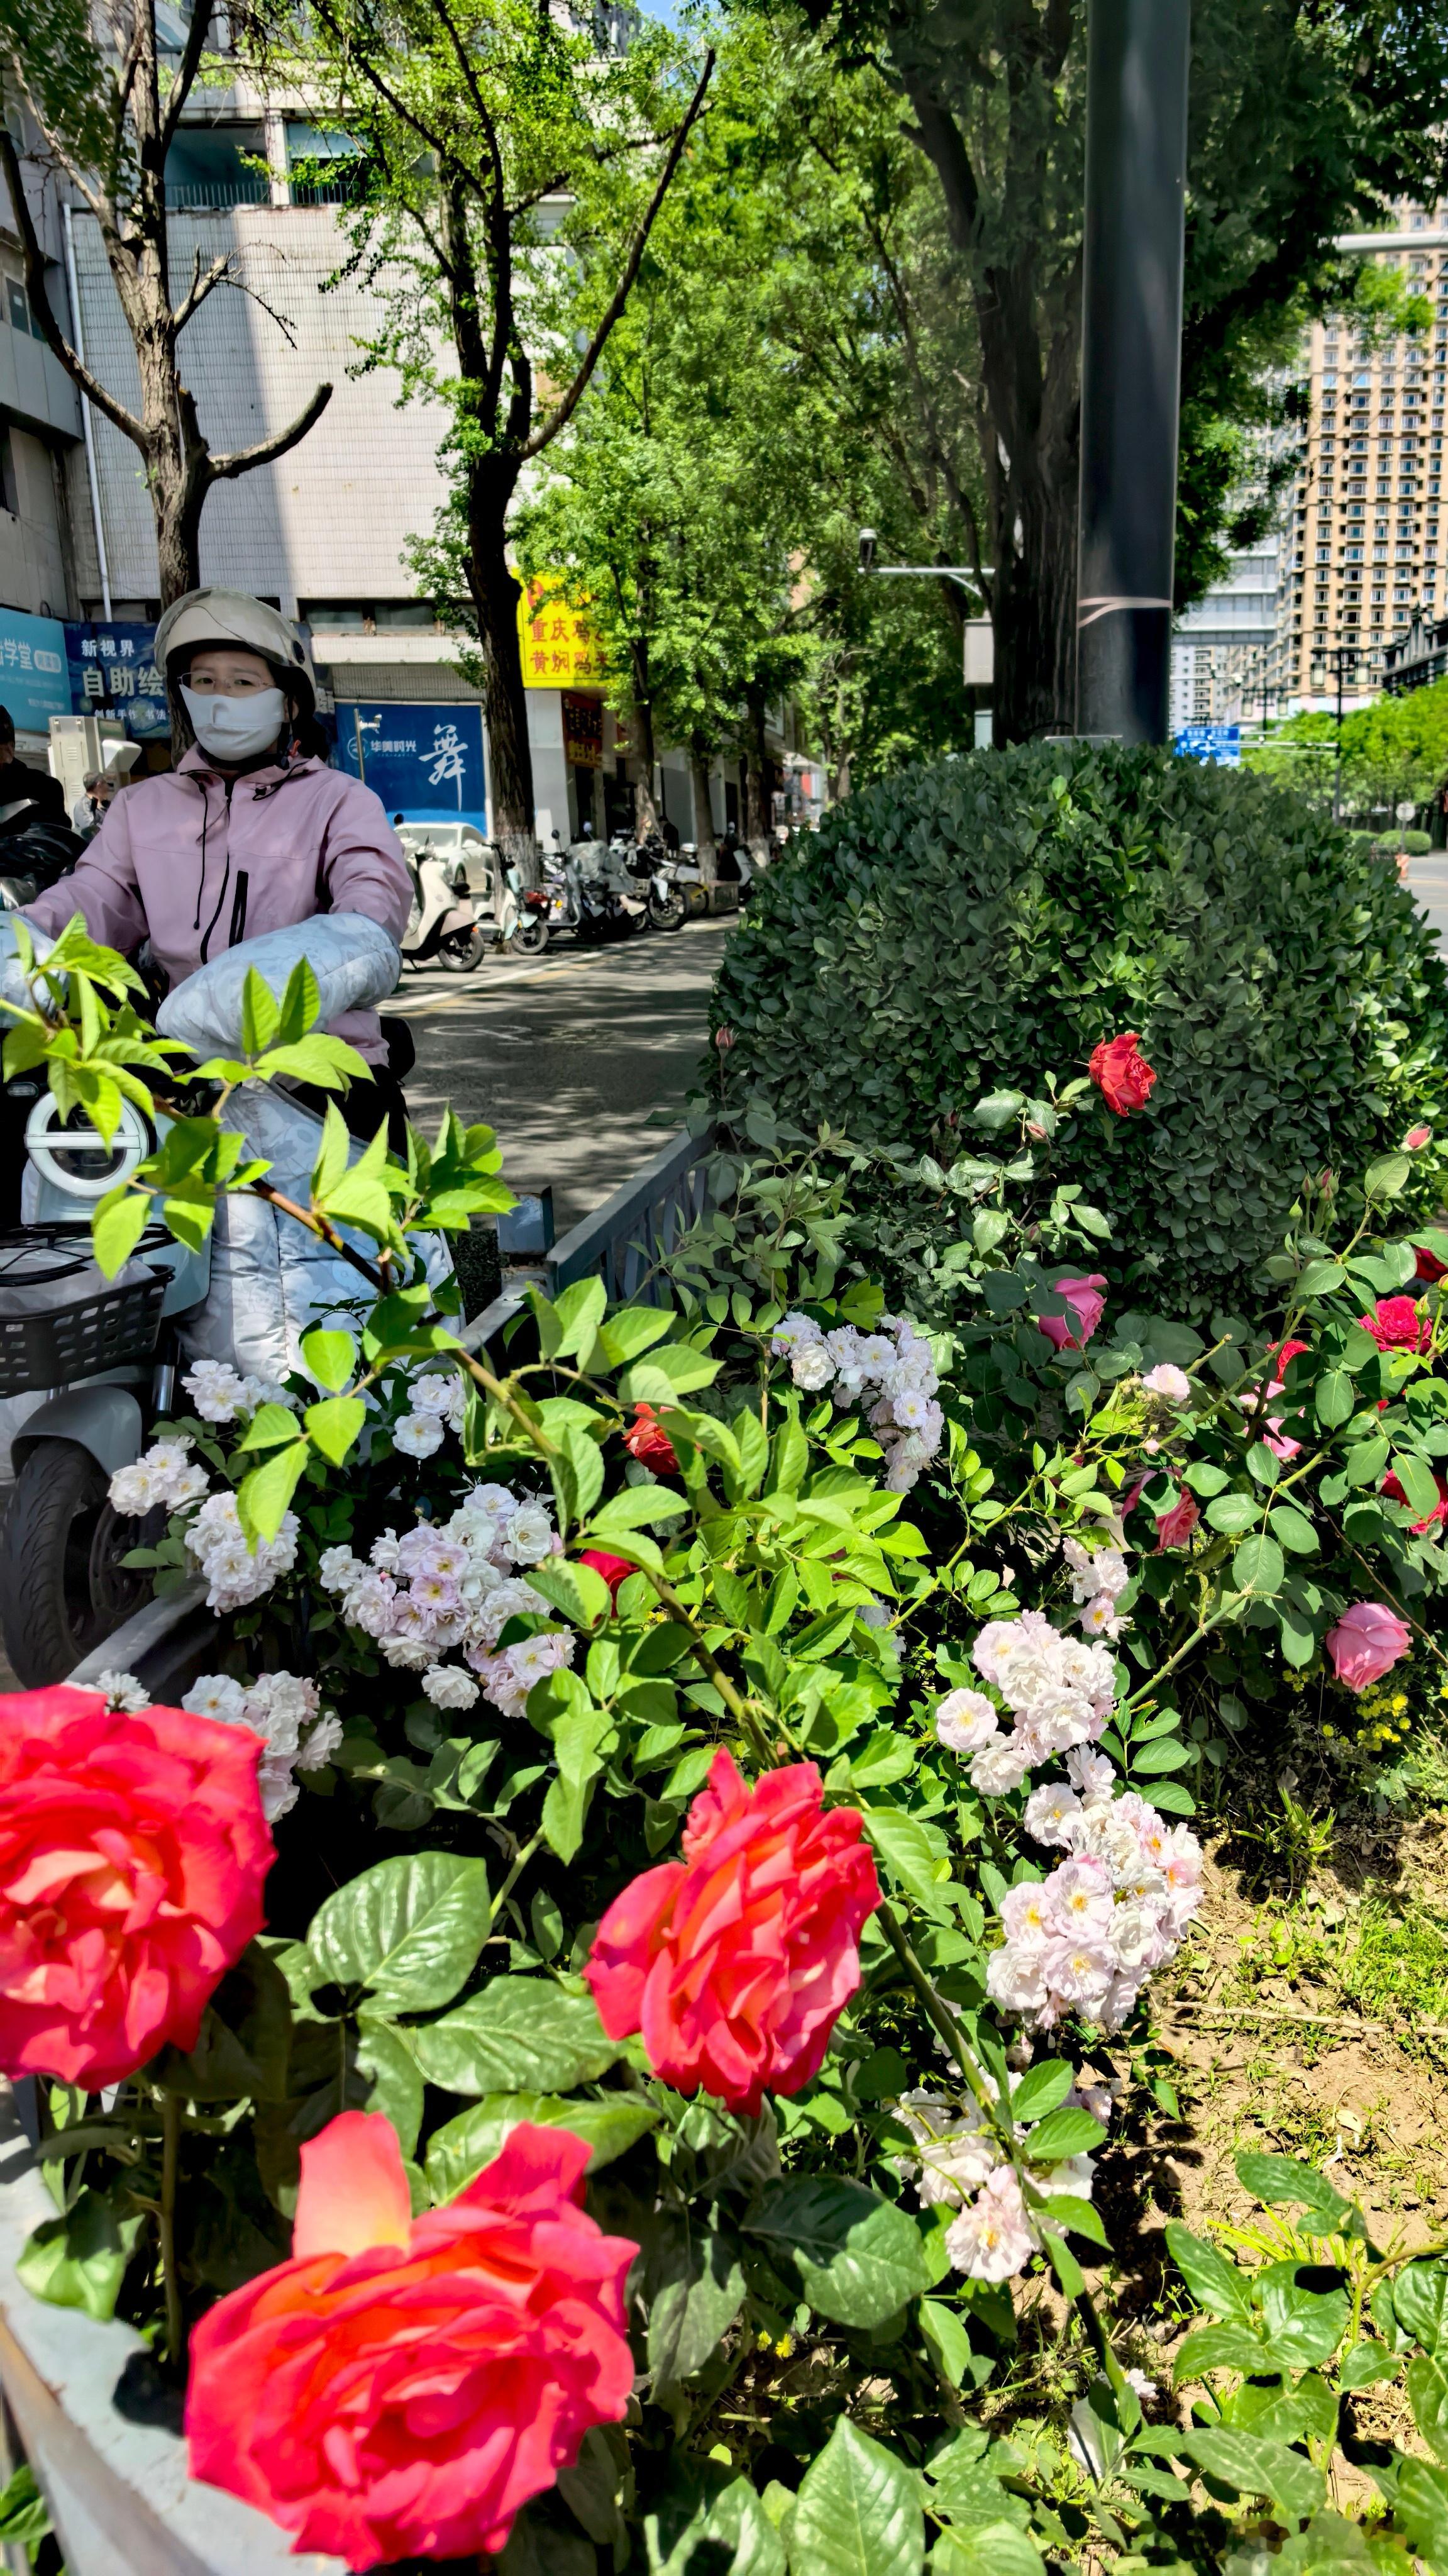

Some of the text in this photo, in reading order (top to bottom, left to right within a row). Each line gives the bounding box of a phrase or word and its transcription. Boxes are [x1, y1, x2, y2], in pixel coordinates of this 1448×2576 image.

[531, 617, 604, 645] 重庆鸡
[81, 639, 135, 657] 新视界
[83, 666, 165, 697] 自助绘
